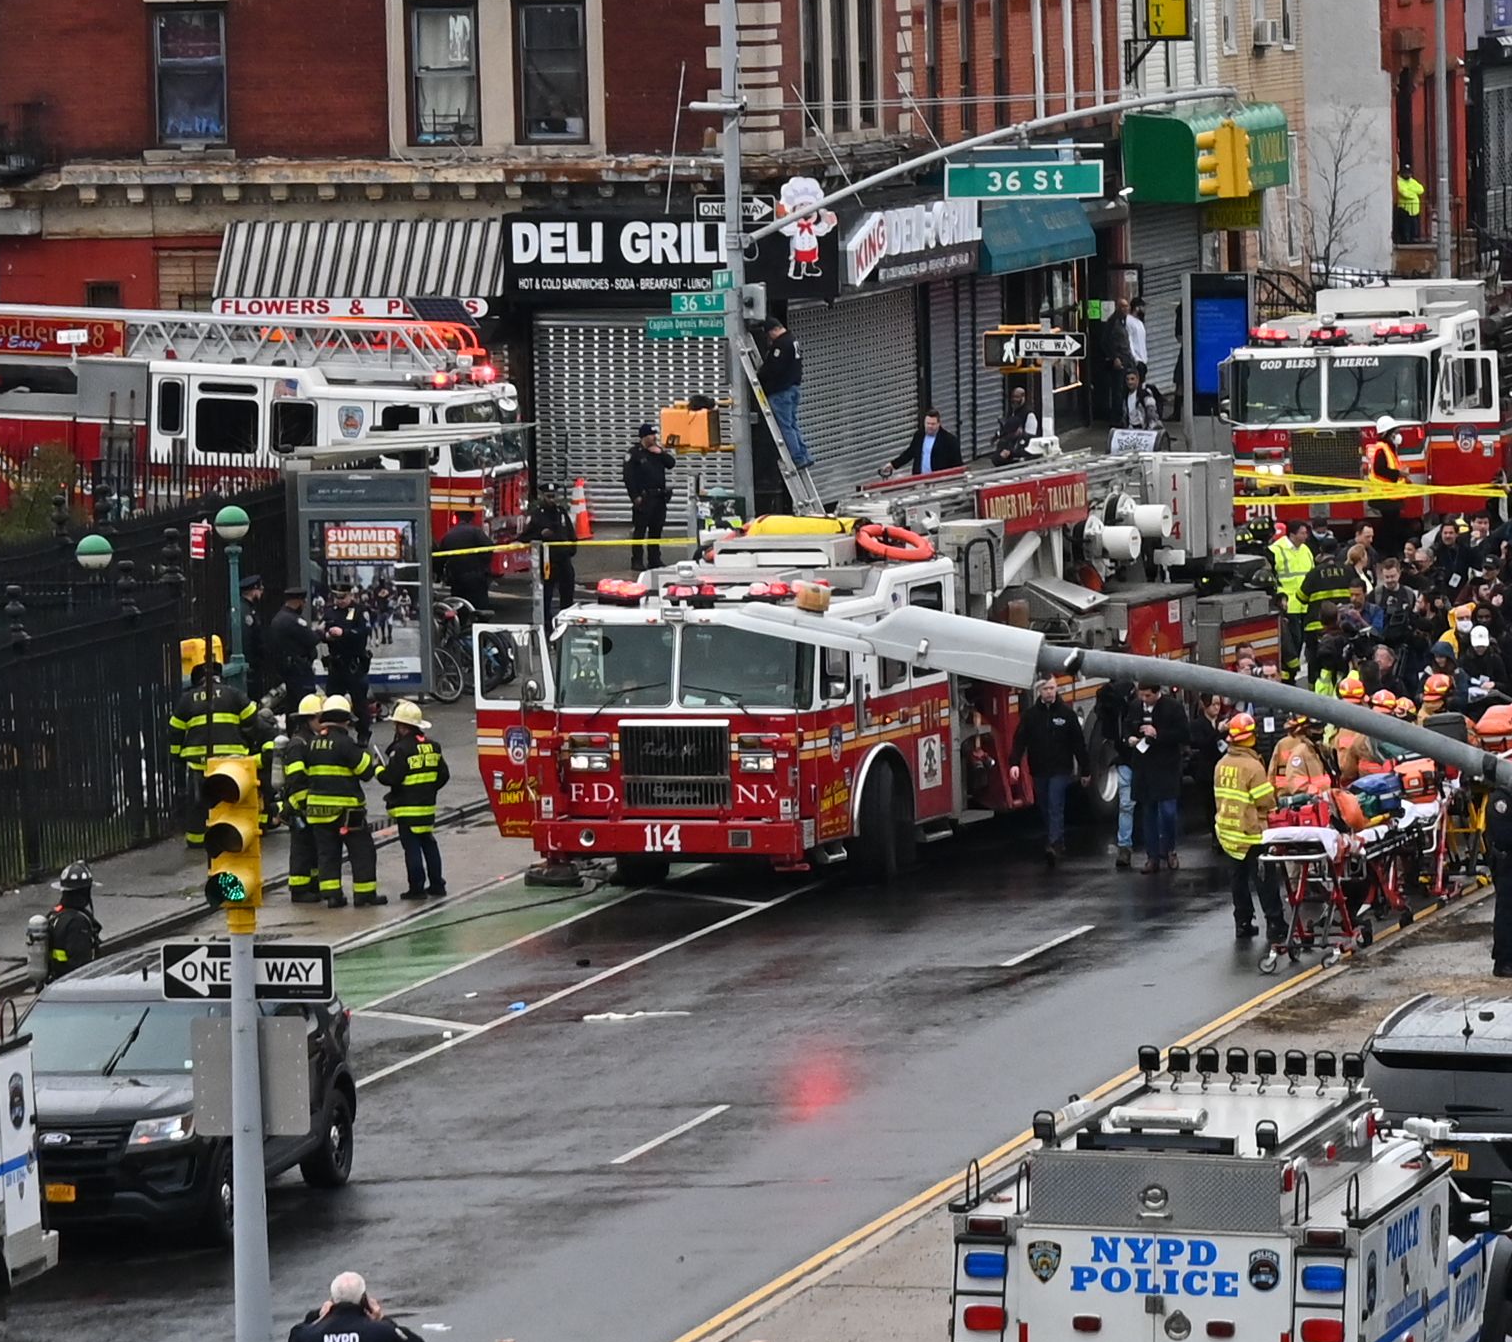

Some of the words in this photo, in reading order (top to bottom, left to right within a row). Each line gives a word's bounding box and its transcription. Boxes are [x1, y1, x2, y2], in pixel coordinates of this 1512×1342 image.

[986, 169, 1022, 193] 36
[1032, 167, 1064, 192] St
[512, 221, 604, 264] DELI
[856, 217, 886, 275] KING
[519, 278, 535, 290] HOT
[542, 278, 561, 290] COLD
[562, 277, 610, 291] SANDWICHES
[614, 278, 635, 291] SODA
[639, 277, 682, 291] BREAKFAST
[686, 277, 712, 291] LUNCH
[220, 299, 331, 316] FLOWERS
[348, 299, 365, 316] &
[387, 299, 479, 317] PLS
[679, 293, 698, 311] 36
[704, 292, 717, 306] ST
[648, 319, 673, 332] Captain
[674, 318, 698, 330] Dennis
[698, 316, 724, 330] Morales
[1023, 334, 1047, 352] ONE
[1051, 335, 1076, 352] WAY
[1259, 361, 1284, 371] GOD
[1285, 359, 1317, 370] BLESS
[1331, 357, 1380, 368] AMERICA
[984, 496, 1018, 520] LADDER
[1047, 487, 1075, 513] TALLY
[327, 529, 398, 543] SUMMER
[327, 543, 398, 558] STREETS
[569, 783, 620, 803] F.D.
[643, 824, 682, 853] 114
[180, 960, 232, 982] ONE
[264, 960, 316, 982] WAY
[1385, 1205, 1421, 1268] POLICE
[1090, 1235, 1218, 1267] NYPD
[1250, 1250, 1280, 1263] POLICE
[1069, 1265, 1240, 1298] POLICE
